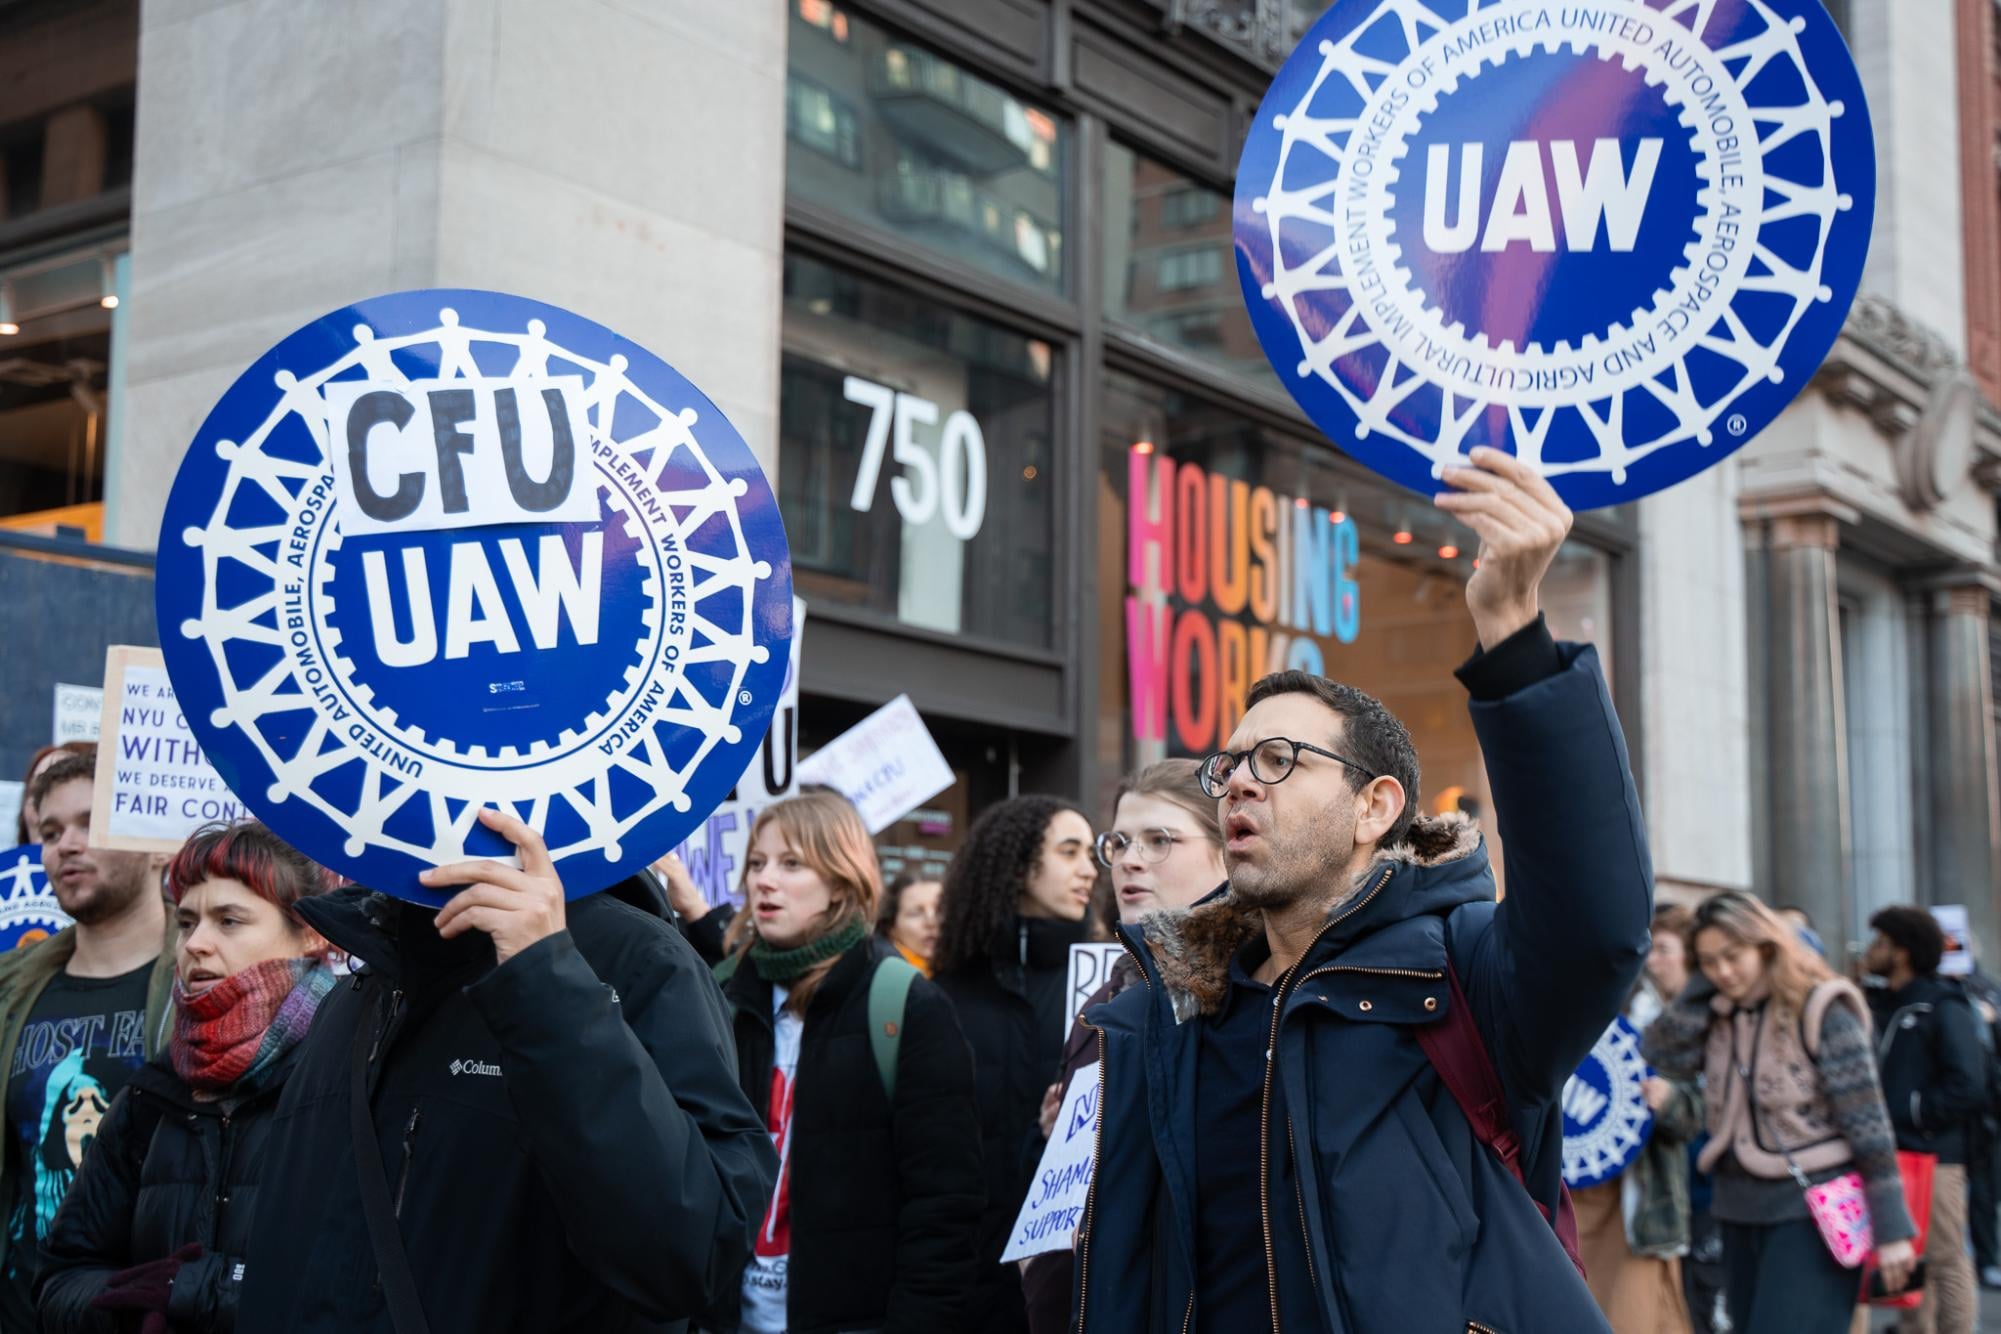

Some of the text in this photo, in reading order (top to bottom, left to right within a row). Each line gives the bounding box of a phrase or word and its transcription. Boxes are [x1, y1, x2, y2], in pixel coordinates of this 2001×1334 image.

[1346, 8, 1744, 392] UNITED AUTOMOBILE, AEROSPACE AND AGRICULTURAL IMPLEMENT WORKERS OF AMERICA
[1423, 138, 1664, 253] UAW
[346, 387, 575, 523] CFU
[843, 376, 987, 540] 750
[287, 465, 335, 568] AEROSPA
[1127, 444, 1360, 644] HOUSING
[361, 531, 604, 668] UAW
[661, 533, 686, 636] WORKERS
[127, 683, 149, 696] WE
[284, 577, 350, 722] AUTOMOBILE,
[661, 645, 679, 673] OF
[122, 707, 165, 727] NYU
[122, 735, 213, 766] WITH
[348, 723, 423, 778] UNITED
[598, 680, 665, 756] AMERICA
[115, 792, 168, 816] FAIR
[118, 770, 142, 785] WE
[150, 773, 217, 792] DESERVE
[1019, 1206, 1085, 1245] SUPPOR
